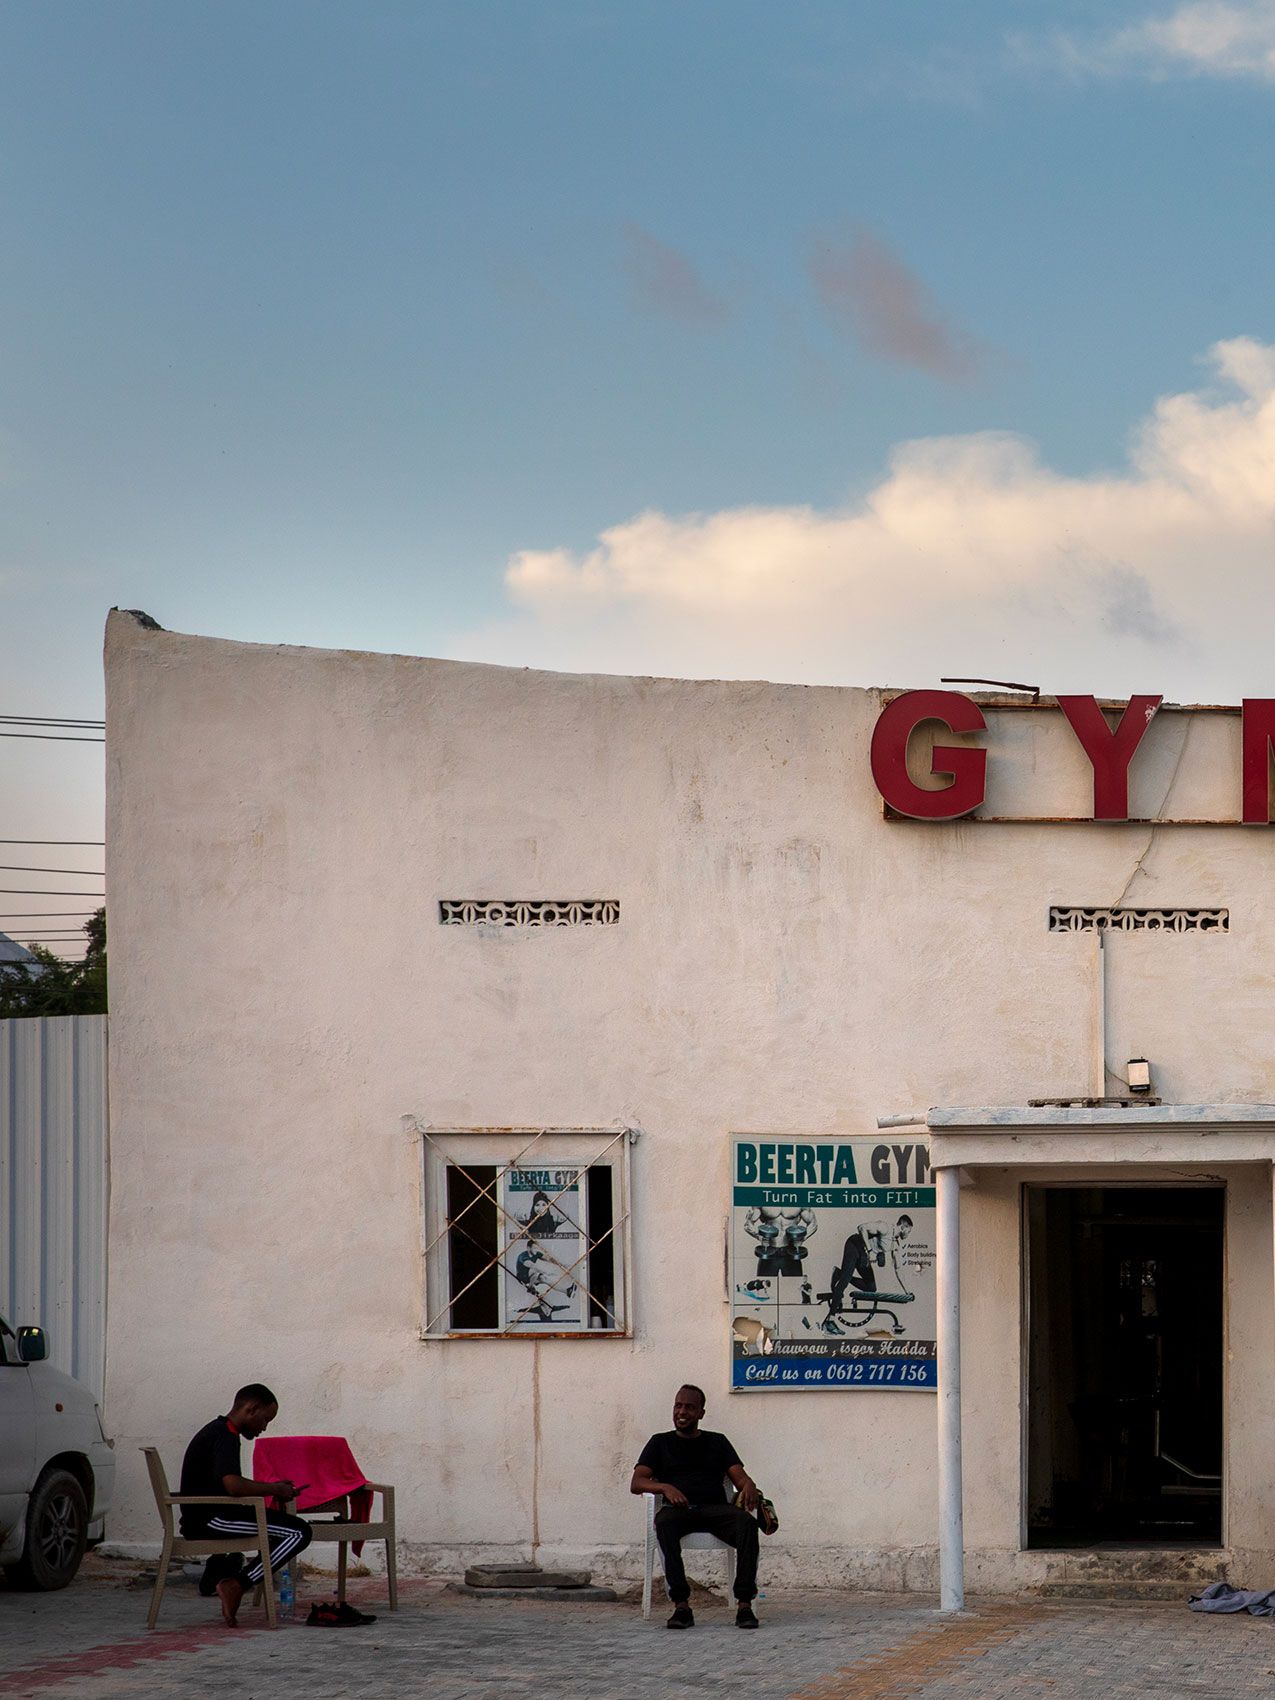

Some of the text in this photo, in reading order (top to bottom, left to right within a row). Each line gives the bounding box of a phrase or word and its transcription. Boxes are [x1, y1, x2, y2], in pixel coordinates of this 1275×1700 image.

[737, 1143, 858, 1185] BEERTA
[511, 1171, 551, 1184] BEERTA
[763, 1190, 918, 1204] Turn Fat into FIT!
[878, 1341, 927, 1356] Hadda
[745, 1364, 927, 1381] Call us on 0612 717 156
